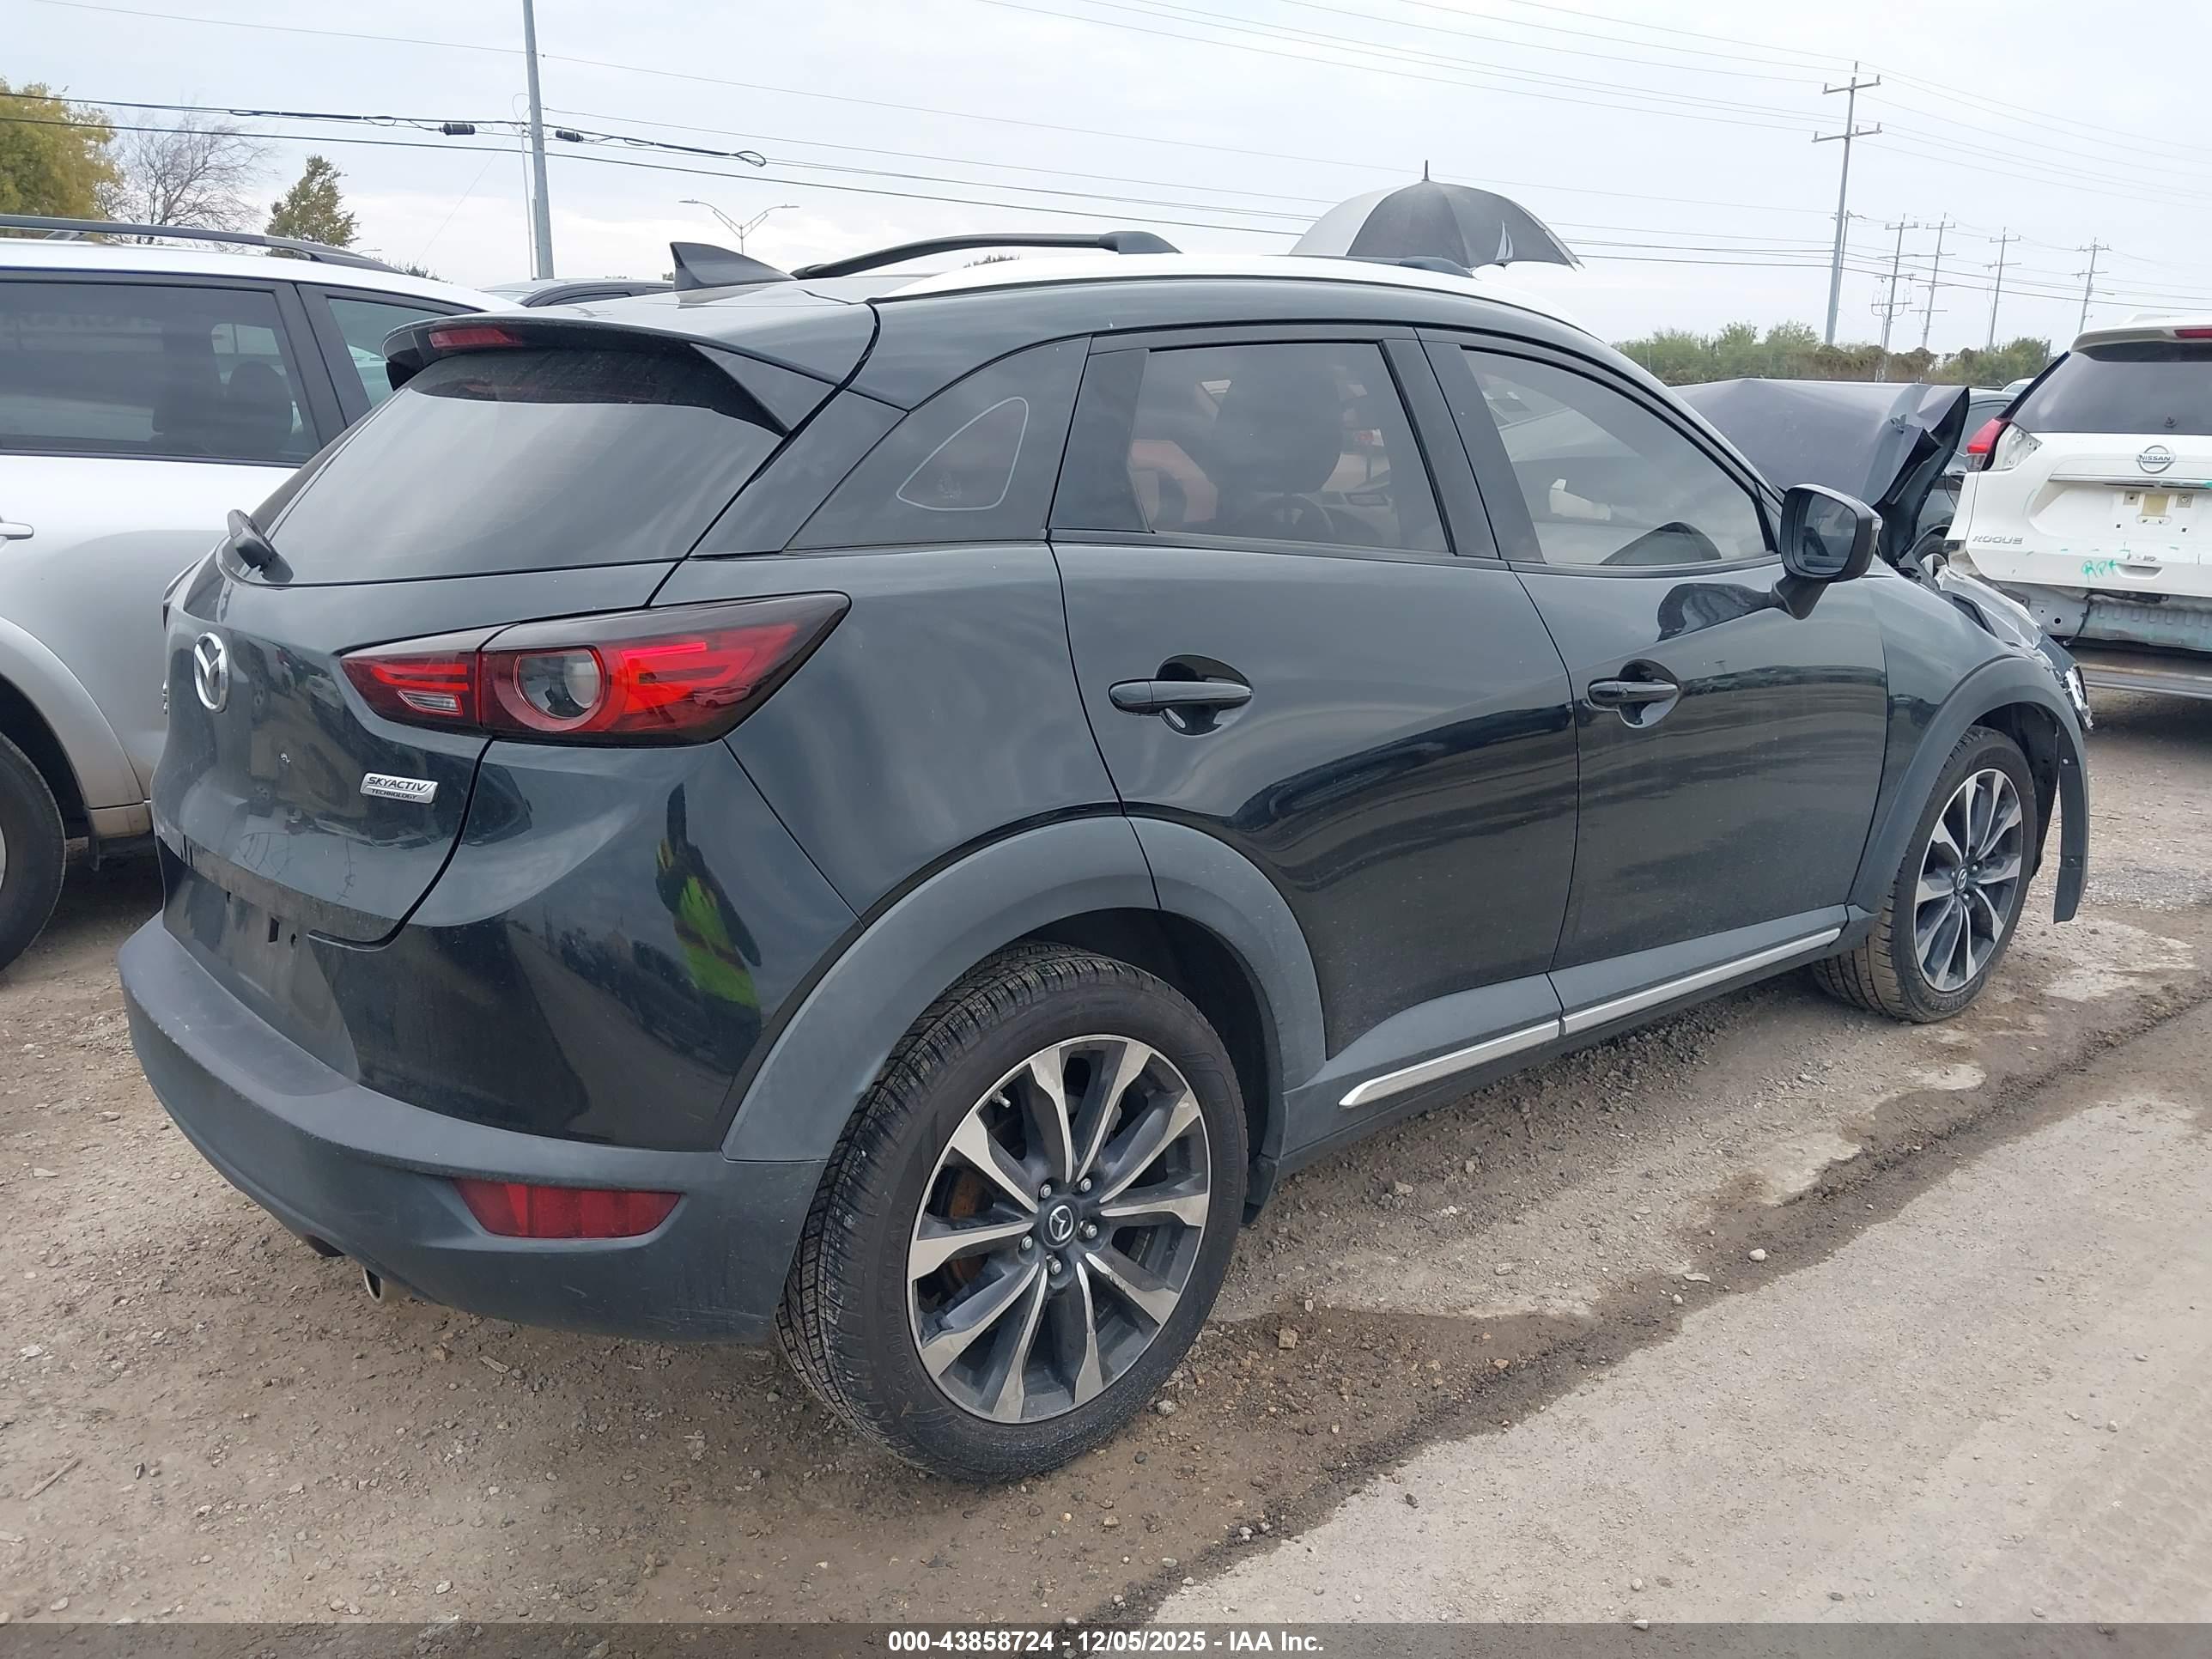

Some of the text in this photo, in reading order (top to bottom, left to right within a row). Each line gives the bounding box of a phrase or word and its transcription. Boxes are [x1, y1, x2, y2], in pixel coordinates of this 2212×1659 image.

[1972, 535, 2023, 544] ROGUE
[368, 777, 427, 791] SKYACTIV
[372, 789, 417, 799] TECHNOLOGY
